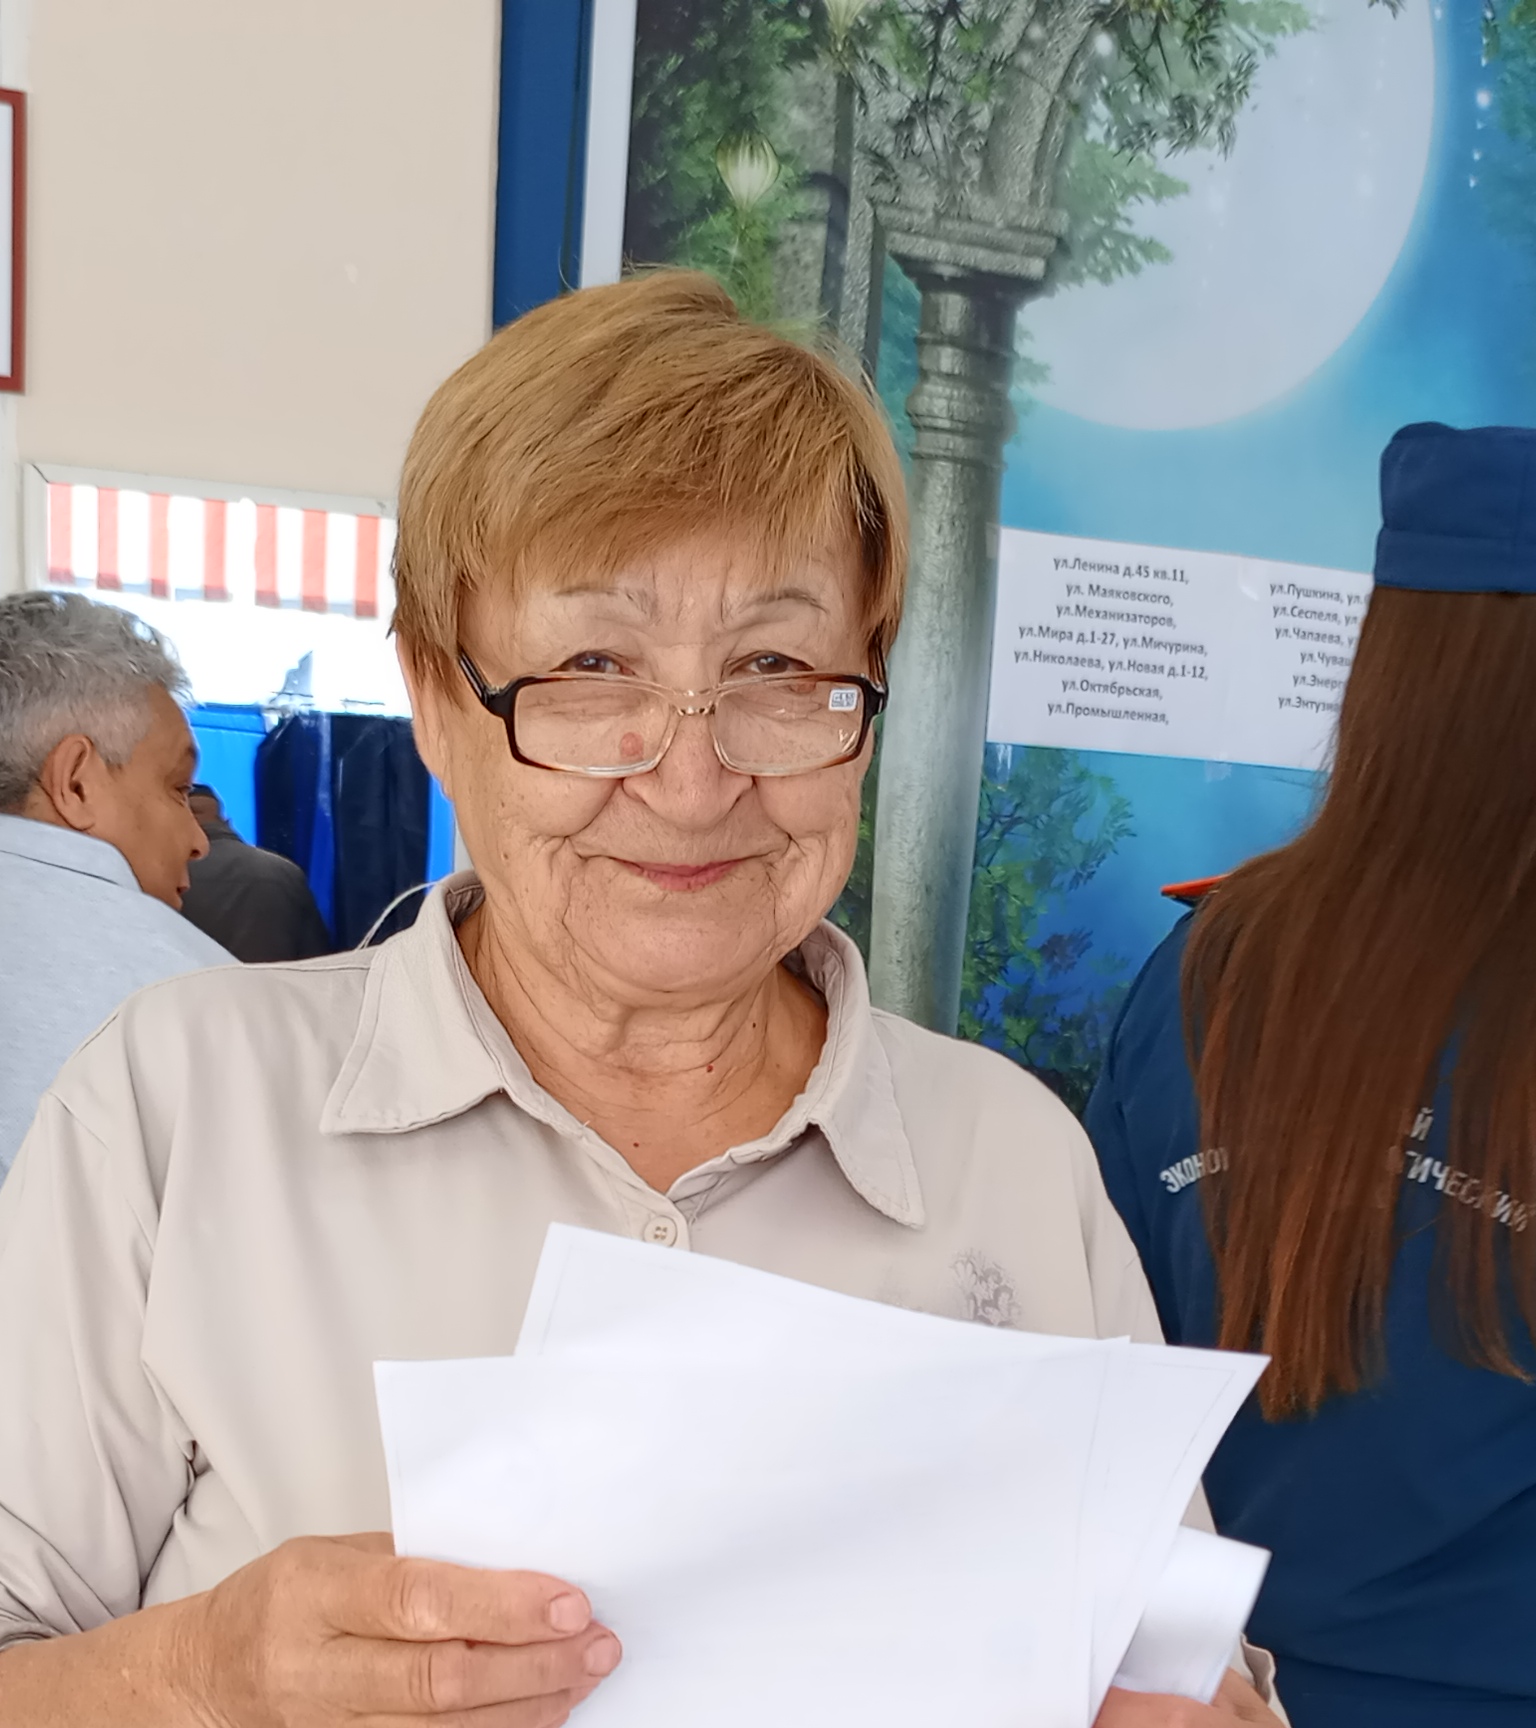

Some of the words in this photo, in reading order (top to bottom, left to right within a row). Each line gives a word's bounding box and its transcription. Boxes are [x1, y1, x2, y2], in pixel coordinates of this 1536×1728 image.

[1053, 556, 1120, 575] ул.Ленина
[1122, 564, 1151, 579] д.45
[1152, 568, 1189, 585] кв.11,
[1066, 583, 1084, 597] ул.
[1088, 583, 1174, 607] Маяковского,
[1269, 583, 1344, 604] ул.Пушкина,
[1056, 604, 1177, 630] ул.Механизаторов,
[1272, 605, 1342, 626] ул.Сеспеля,
[1019, 625, 1073, 643] ул.Мира
[1076, 630, 1119, 648] д.1-27,
[1123, 636, 1208, 657] ул.Мичурина,
[1274, 627, 1344, 646] ул.Чапаева,
[1014, 649, 1105, 671] ул.Николаева,
[1108, 659, 1165, 676] ул.Новая
[1167, 664, 1209, 682] д.1-12,
[1300, 652, 1352, 668] ул.Чуваш
[1061, 679, 1163, 701] ул.Октябрьская,
[1047, 702, 1169, 726] ул.Промышленная,
[1160, 1147, 1229, 1194] ЭКОНО
